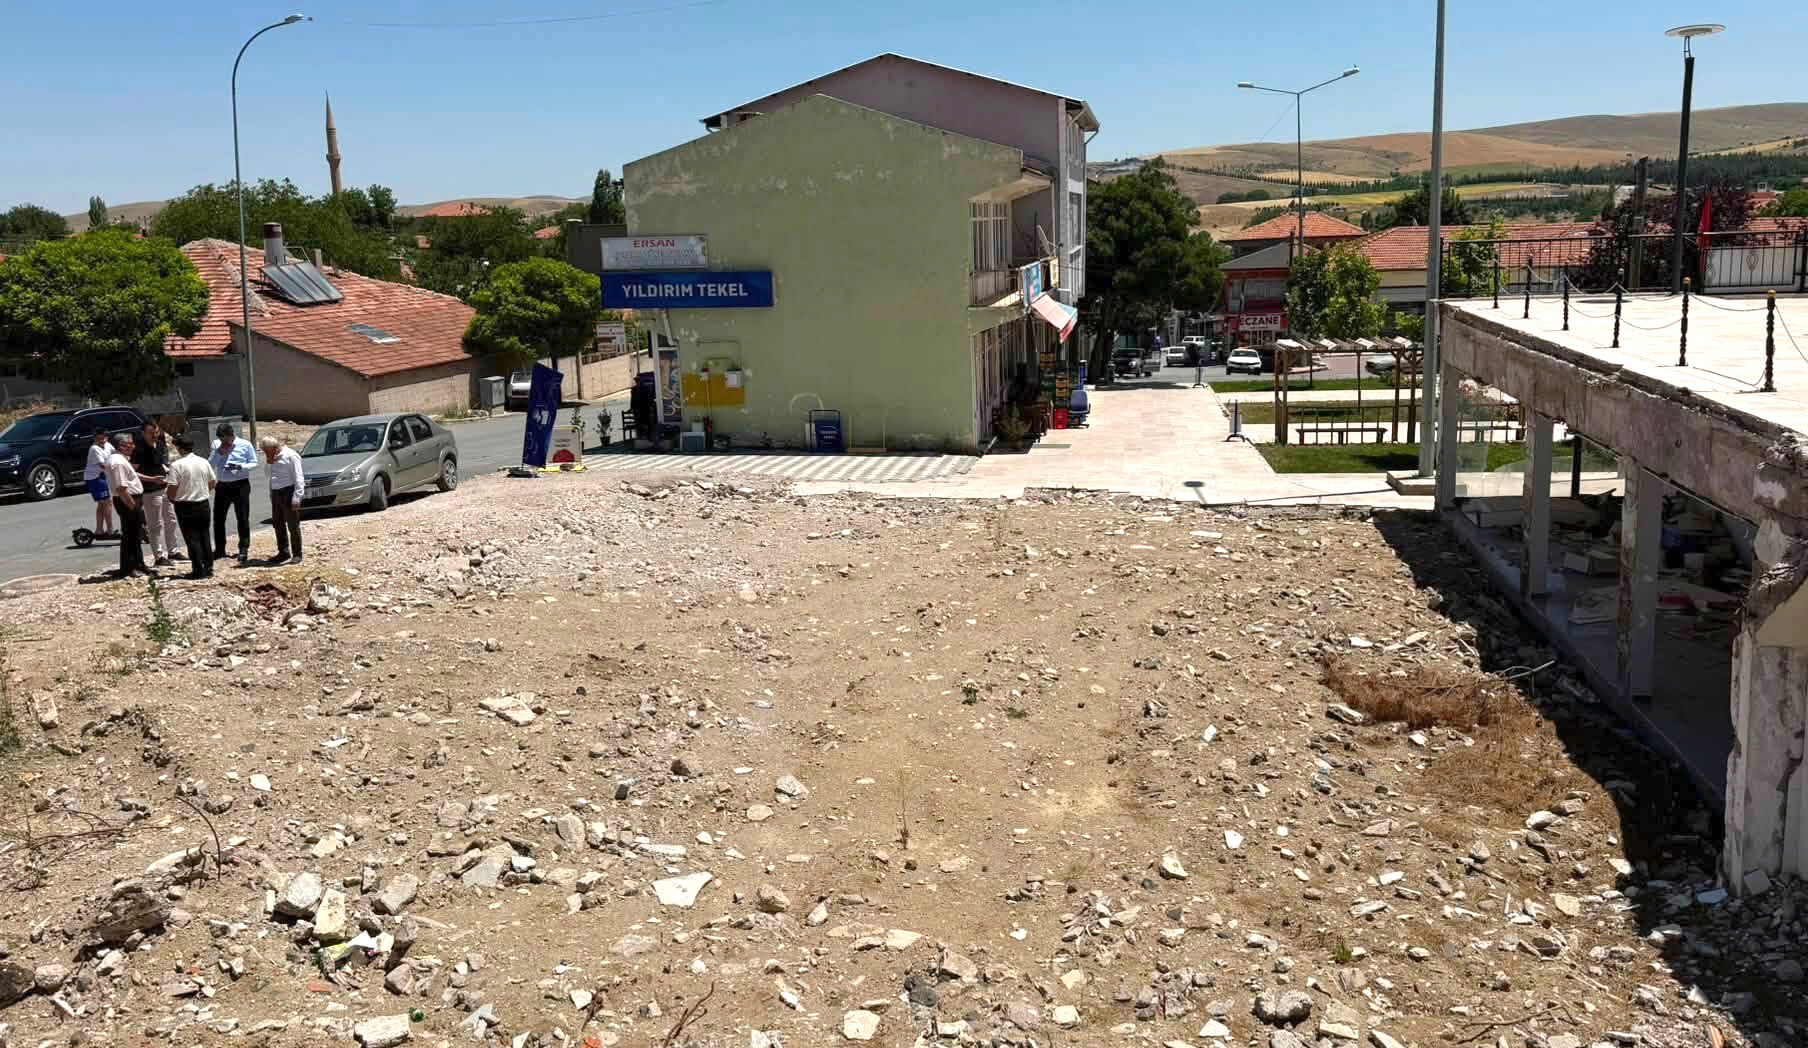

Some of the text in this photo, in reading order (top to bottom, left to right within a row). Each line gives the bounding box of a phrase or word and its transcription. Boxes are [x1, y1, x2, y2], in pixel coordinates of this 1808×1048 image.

[633, 239, 675, 248] ERSAN
[622, 283, 749, 298] YILDIRIM TEKEL
[1240, 315, 1279, 326] ECZANE
